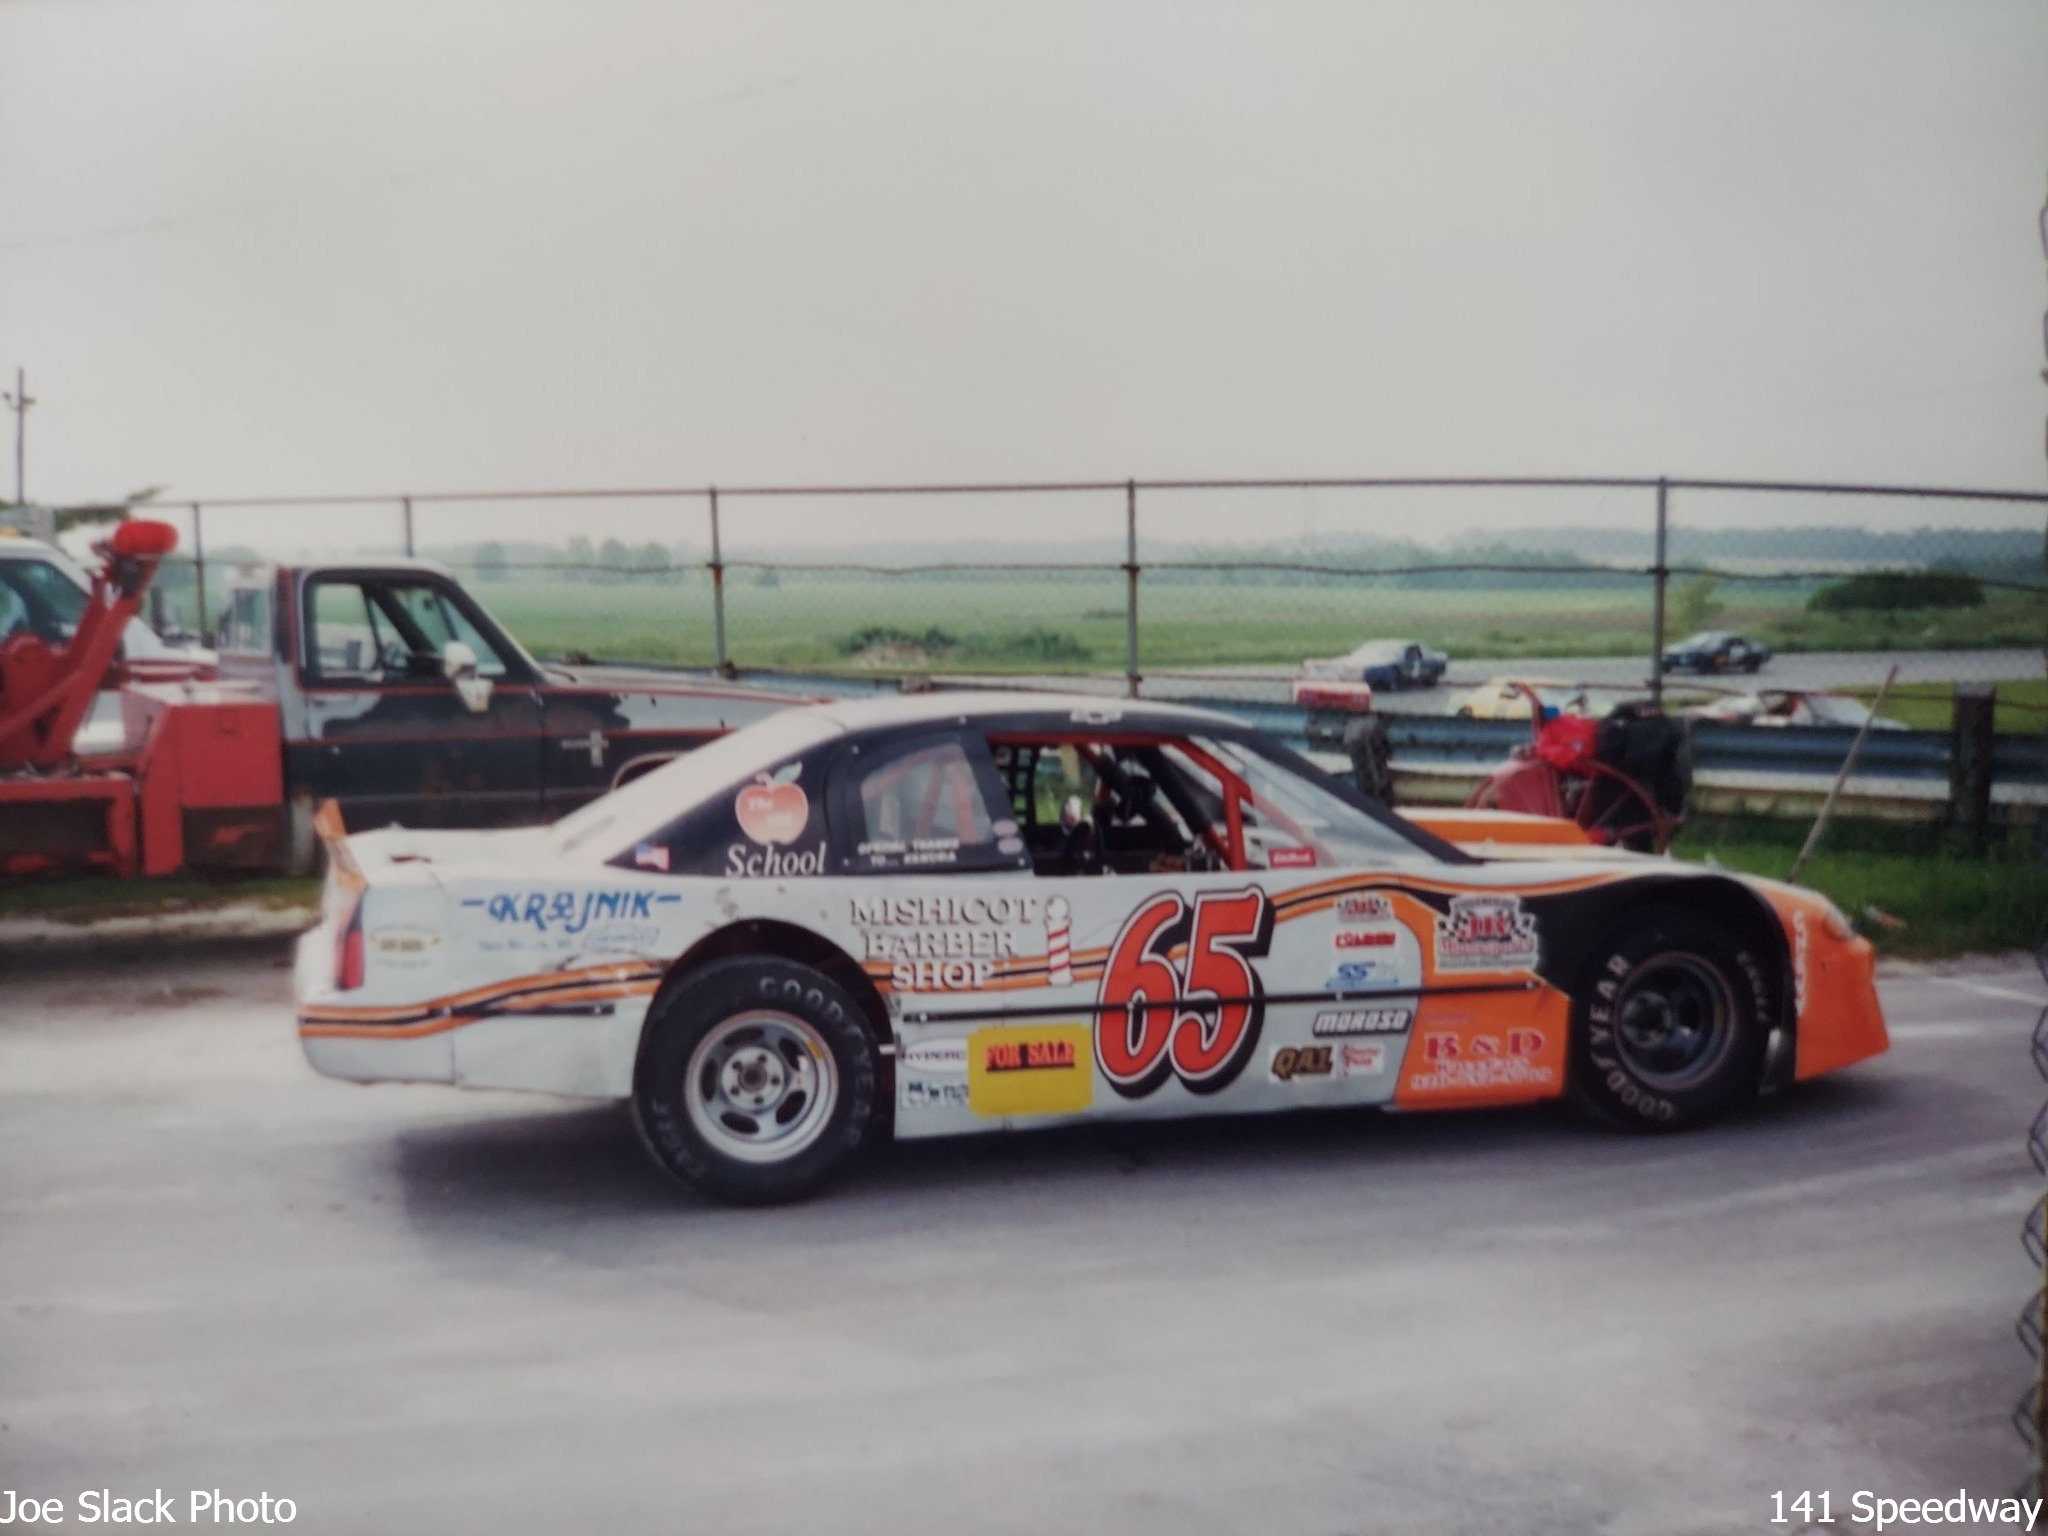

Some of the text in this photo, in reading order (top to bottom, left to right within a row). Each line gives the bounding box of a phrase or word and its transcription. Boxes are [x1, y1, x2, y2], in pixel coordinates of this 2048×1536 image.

[725, 840, 827, 878] School
[849, 896, 1036, 927] MISHICOT
[861, 929, 1018, 961] BARBER
[890, 959, 996, 992] SHOP
[1094, 884, 1272, 1098] 65
[1313, 1009, 1410, 1035] MOROSO
[1589, 953, 1675, 1120] GOODYEAR
[759, 976, 875, 1147] GOODYEAR
[986, 1040, 1075, 1070] FOR SALE
